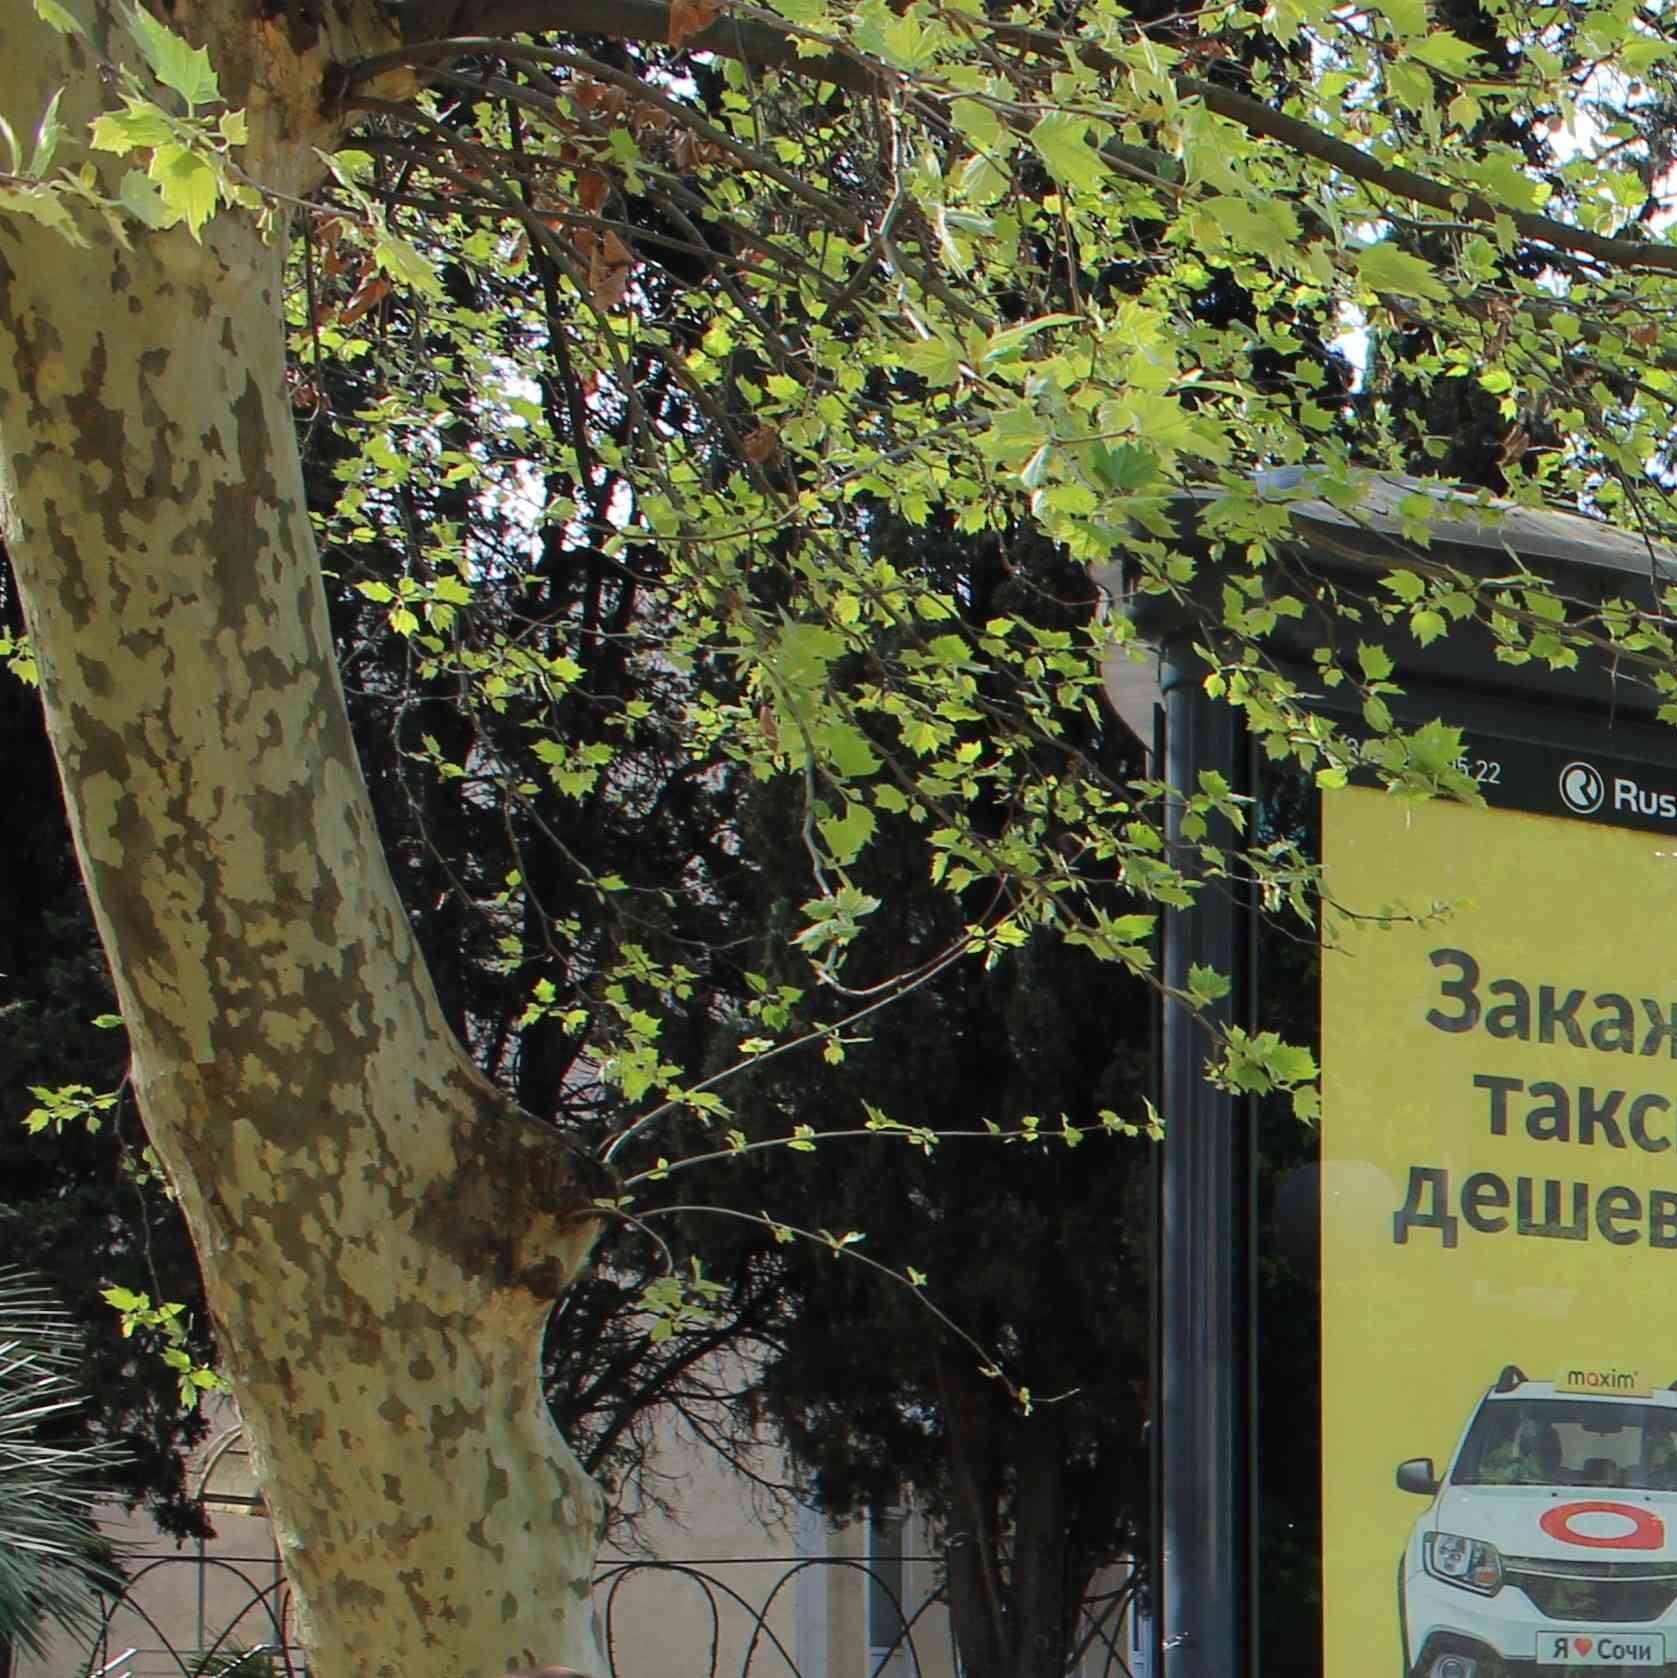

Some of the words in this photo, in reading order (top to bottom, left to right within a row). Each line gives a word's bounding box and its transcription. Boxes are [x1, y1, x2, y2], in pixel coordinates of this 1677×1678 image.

[1475, 760, 1501, 785] 22
[1554, 1638, 1568, 1659] Я
[1598, 1638, 1651, 1660] Сочи
